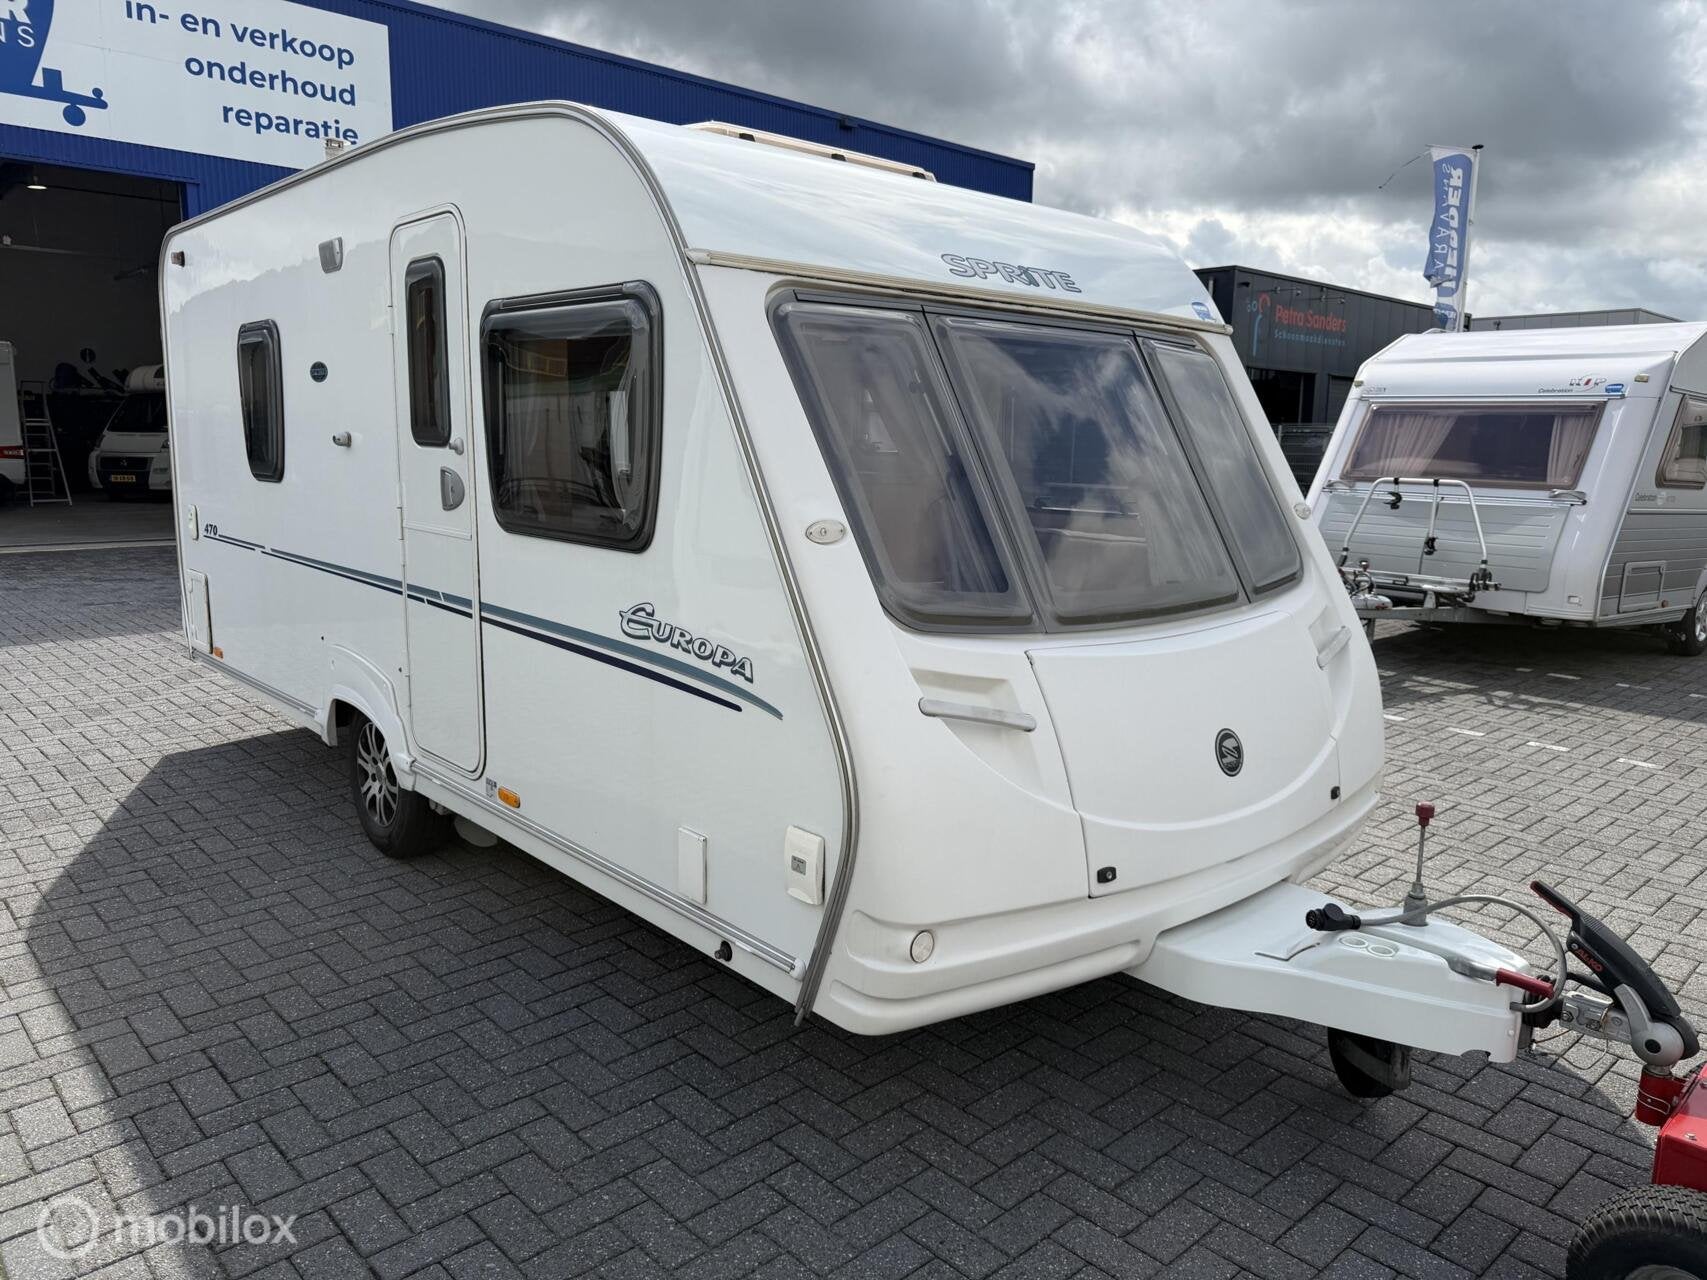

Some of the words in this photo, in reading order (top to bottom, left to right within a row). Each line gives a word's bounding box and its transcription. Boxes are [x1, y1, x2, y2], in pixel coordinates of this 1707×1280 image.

[180, 12, 221, 38] en
[230, 22, 355, 70] verkoop
[185, 55, 356, 107] onderhoud
[222, 104, 359, 146] reparatie
[941, 253, 1082, 293] SPRITE
[1306, 310, 1346, 332] Sanders
[204, 522, 218, 536] 470
